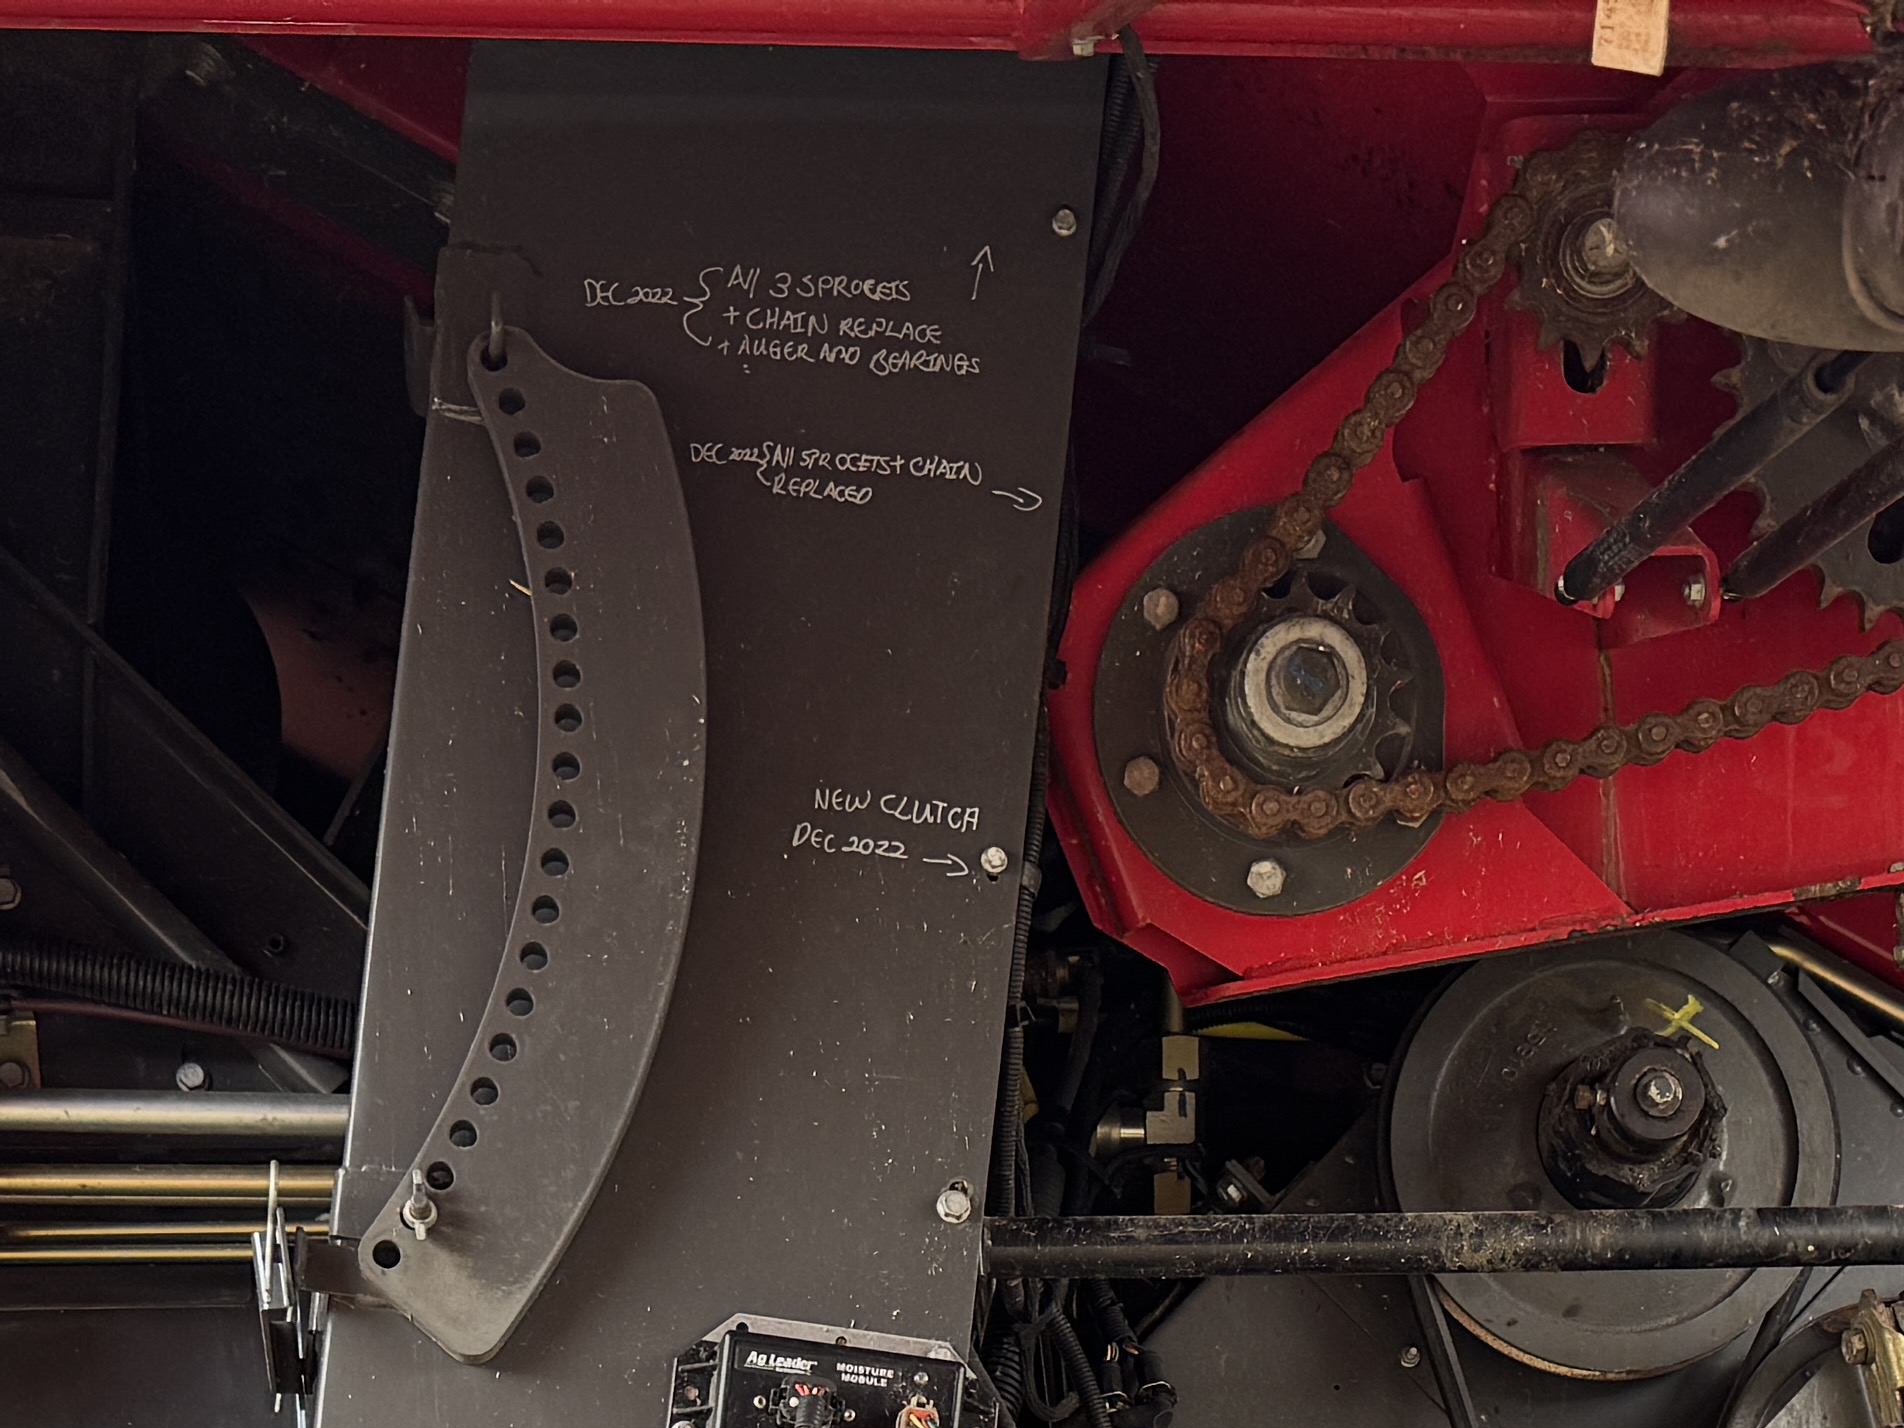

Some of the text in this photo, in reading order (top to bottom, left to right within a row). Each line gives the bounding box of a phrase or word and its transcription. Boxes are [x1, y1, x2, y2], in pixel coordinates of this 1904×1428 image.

[584, 278, 625, 307] DEC
[626, 286, 679, 306] 2022
[769, 272, 792, 298] 3
[746, 307, 829, 337] CHAIN
[839, 317, 943, 345] REPLACE
[738, 334, 816, 363] AUGER
[869, 348, 981, 377] BEARINGS
[690, 443, 727, 464] DEC
[909, 455, 983, 486] CHAIN
[772, 472, 873, 505] REPLACED
[814, 788, 872, 813] NEW
[792, 822, 909, 859] DEC 2022
[836, 1362, 895, 1379] MOISTURE
